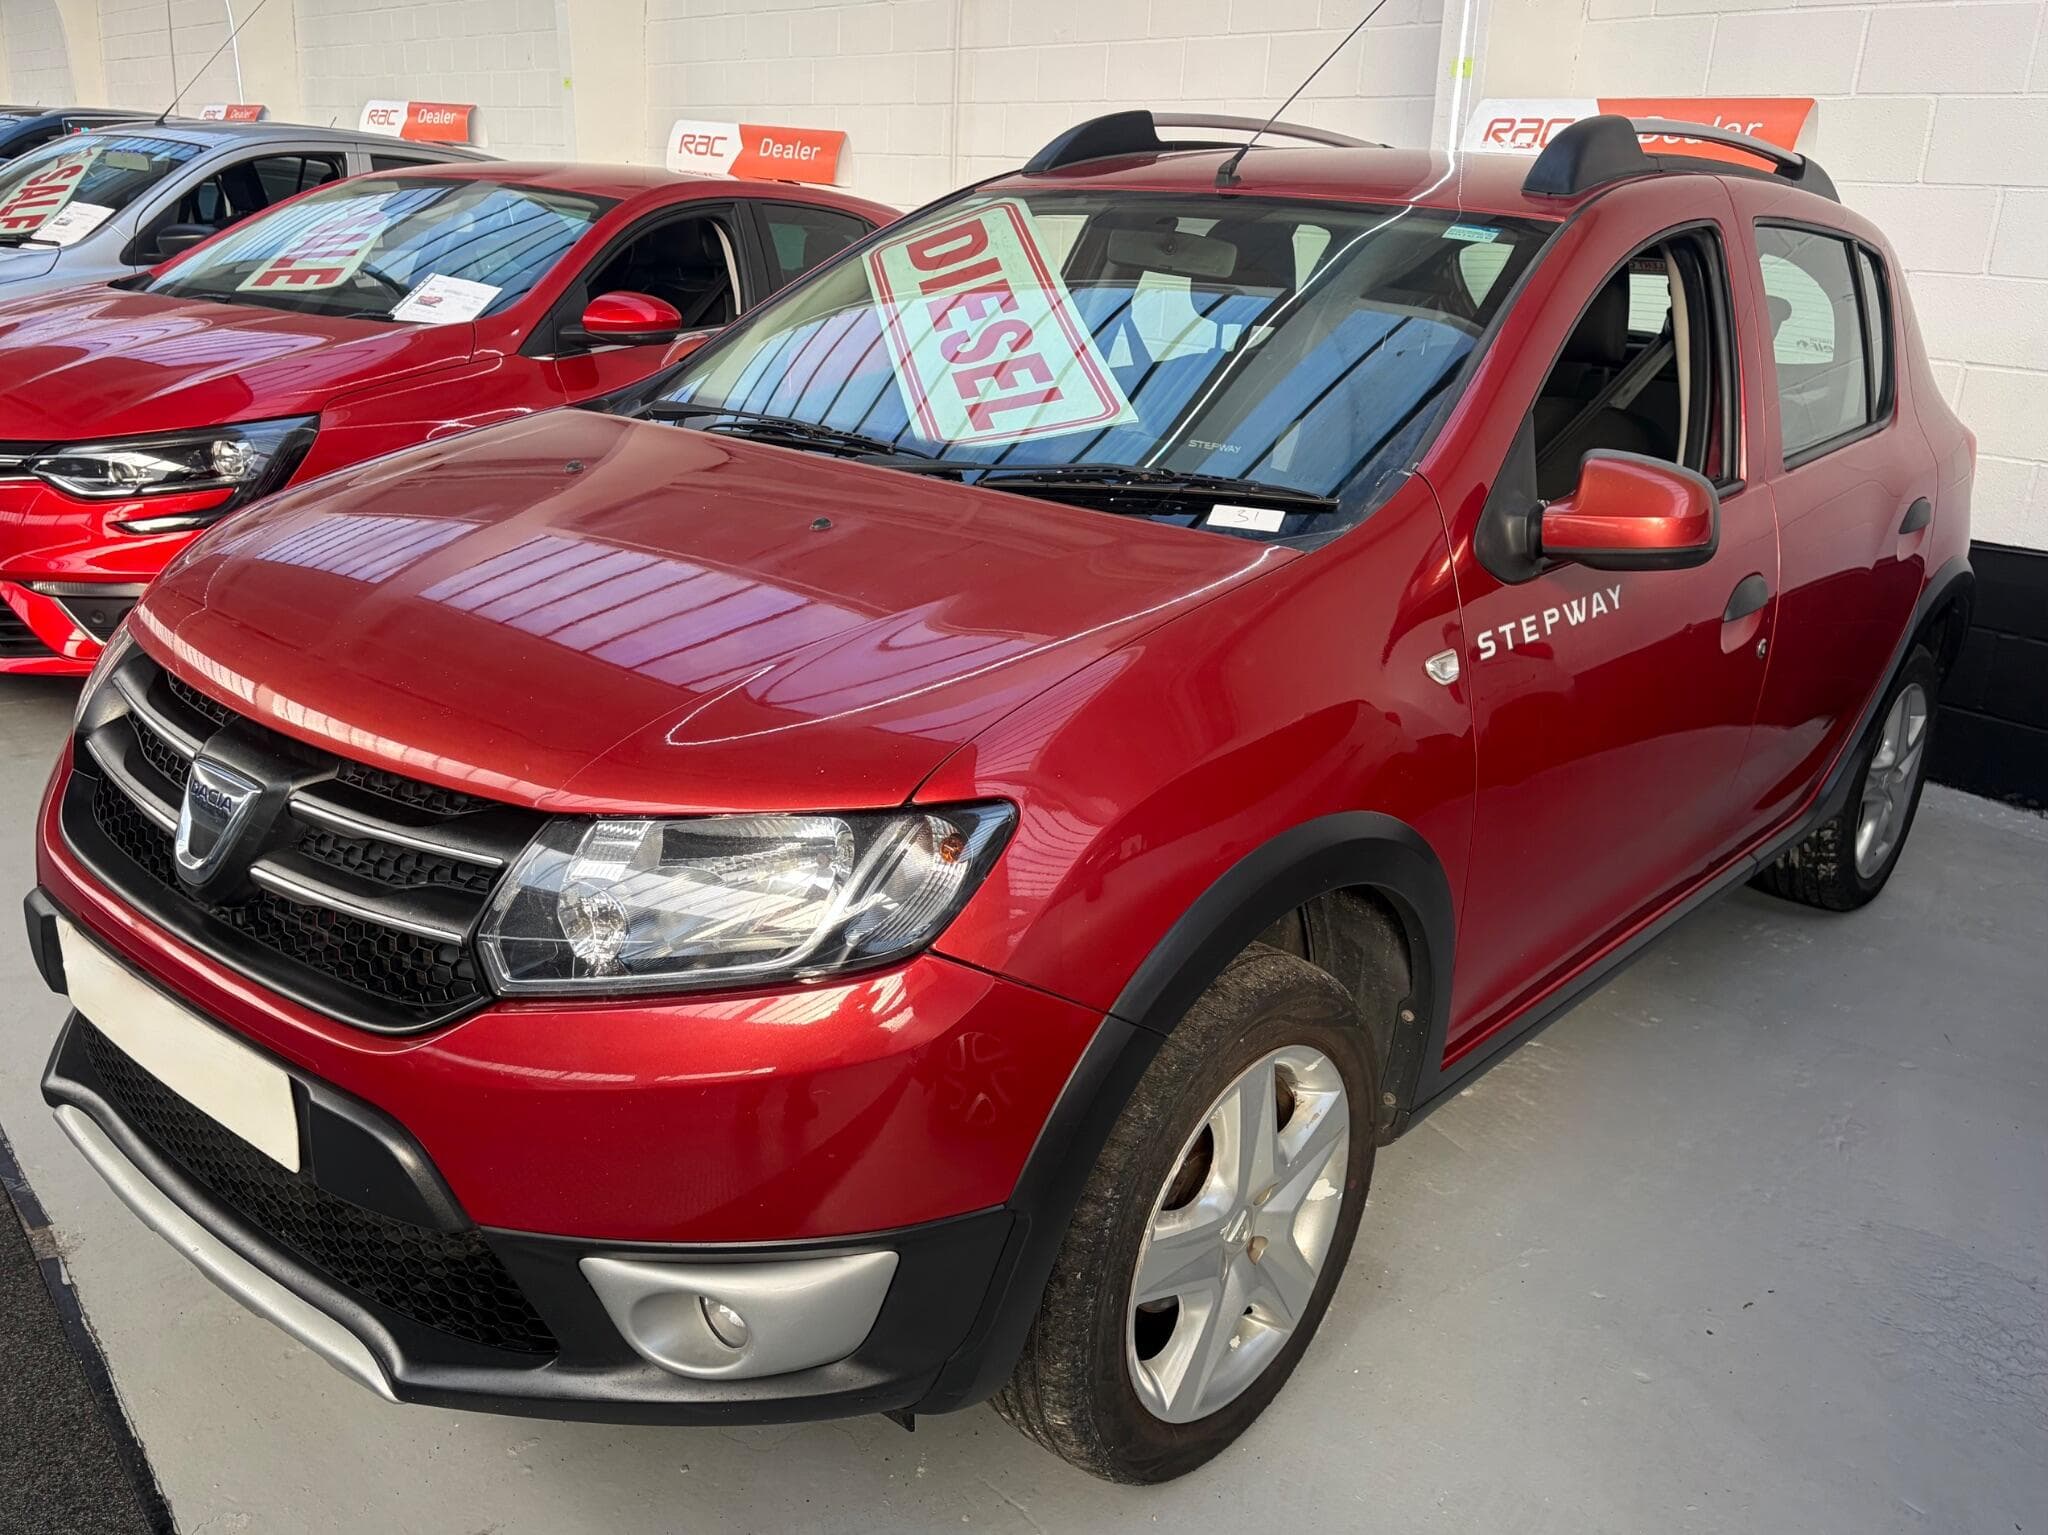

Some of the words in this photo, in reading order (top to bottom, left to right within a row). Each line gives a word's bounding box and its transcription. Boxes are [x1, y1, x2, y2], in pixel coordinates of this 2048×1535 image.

[367, 110, 399, 125] RAC
[417, 104, 457, 124] Dealer
[678, 134, 727, 157] RAC
[759, 138, 821, 160] Dealer
[0, 164, 84, 229] SALE
[906, 218, 1064, 432] DIESEL
[1188, 440, 1242, 453] STEPWAY
[1477, 584, 1622, 661] STEPWAY
[190, 780, 232, 815] DACIA
